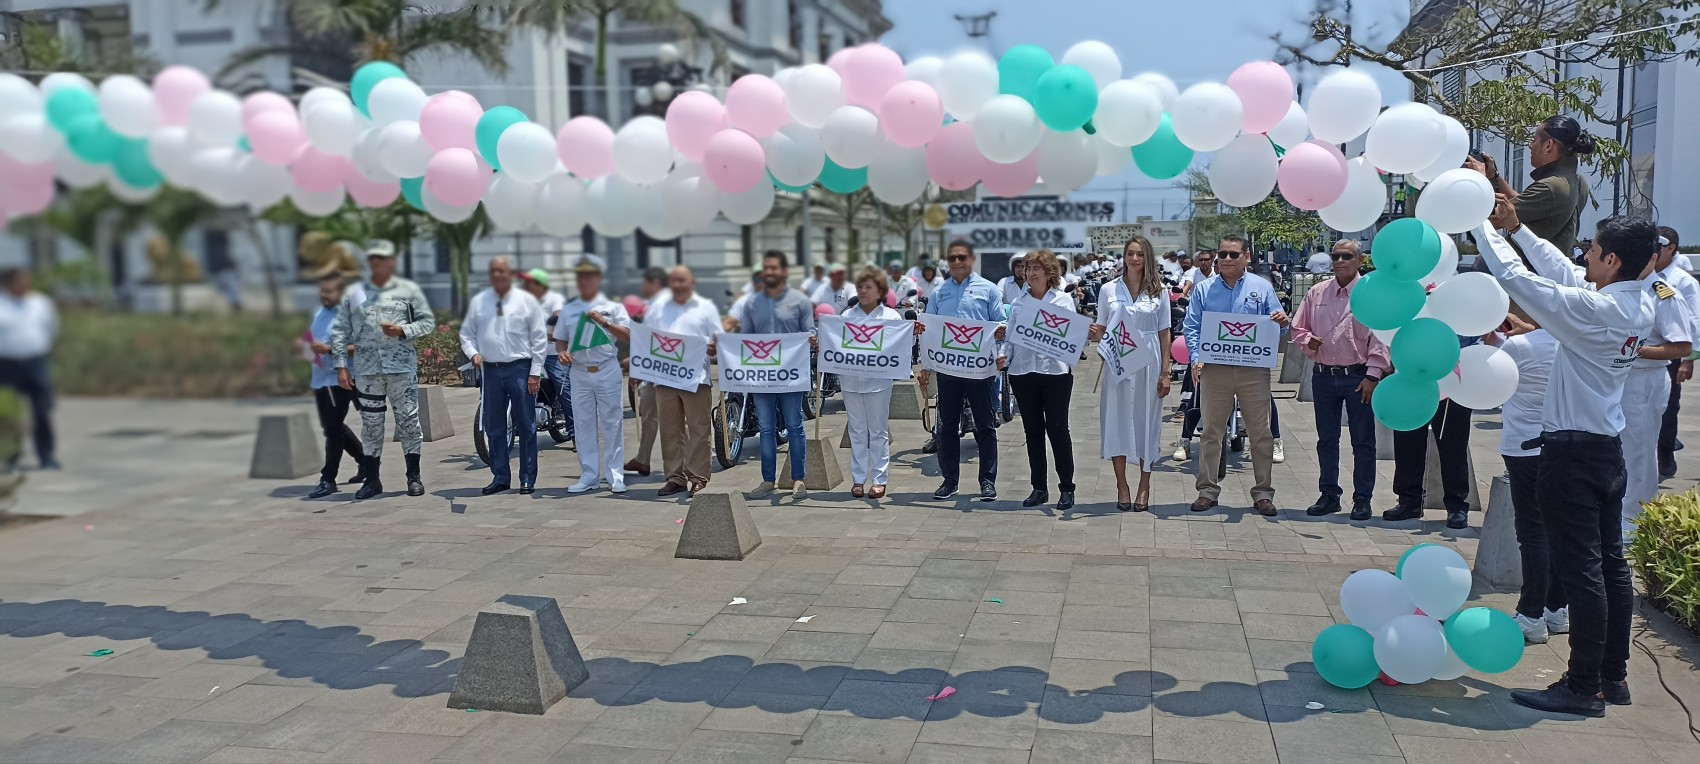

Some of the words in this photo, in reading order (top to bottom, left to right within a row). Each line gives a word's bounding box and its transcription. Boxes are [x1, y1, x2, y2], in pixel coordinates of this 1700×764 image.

[946, 202, 1115, 217] COMUNICACIONES
[970, 228, 1065, 242] CORREOS
[1016, 325, 1077, 354] CORREOS
[1102, 331, 1125, 376] ORROS
[1201, 342, 1271, 356] CORREOS
[824, 350, 899, 367] CORREOS
[928, 349, 994, 368] CORREOS
[631, 355, 694, 380] CORREOS
[725, 368, 799, 381] CORREOS
